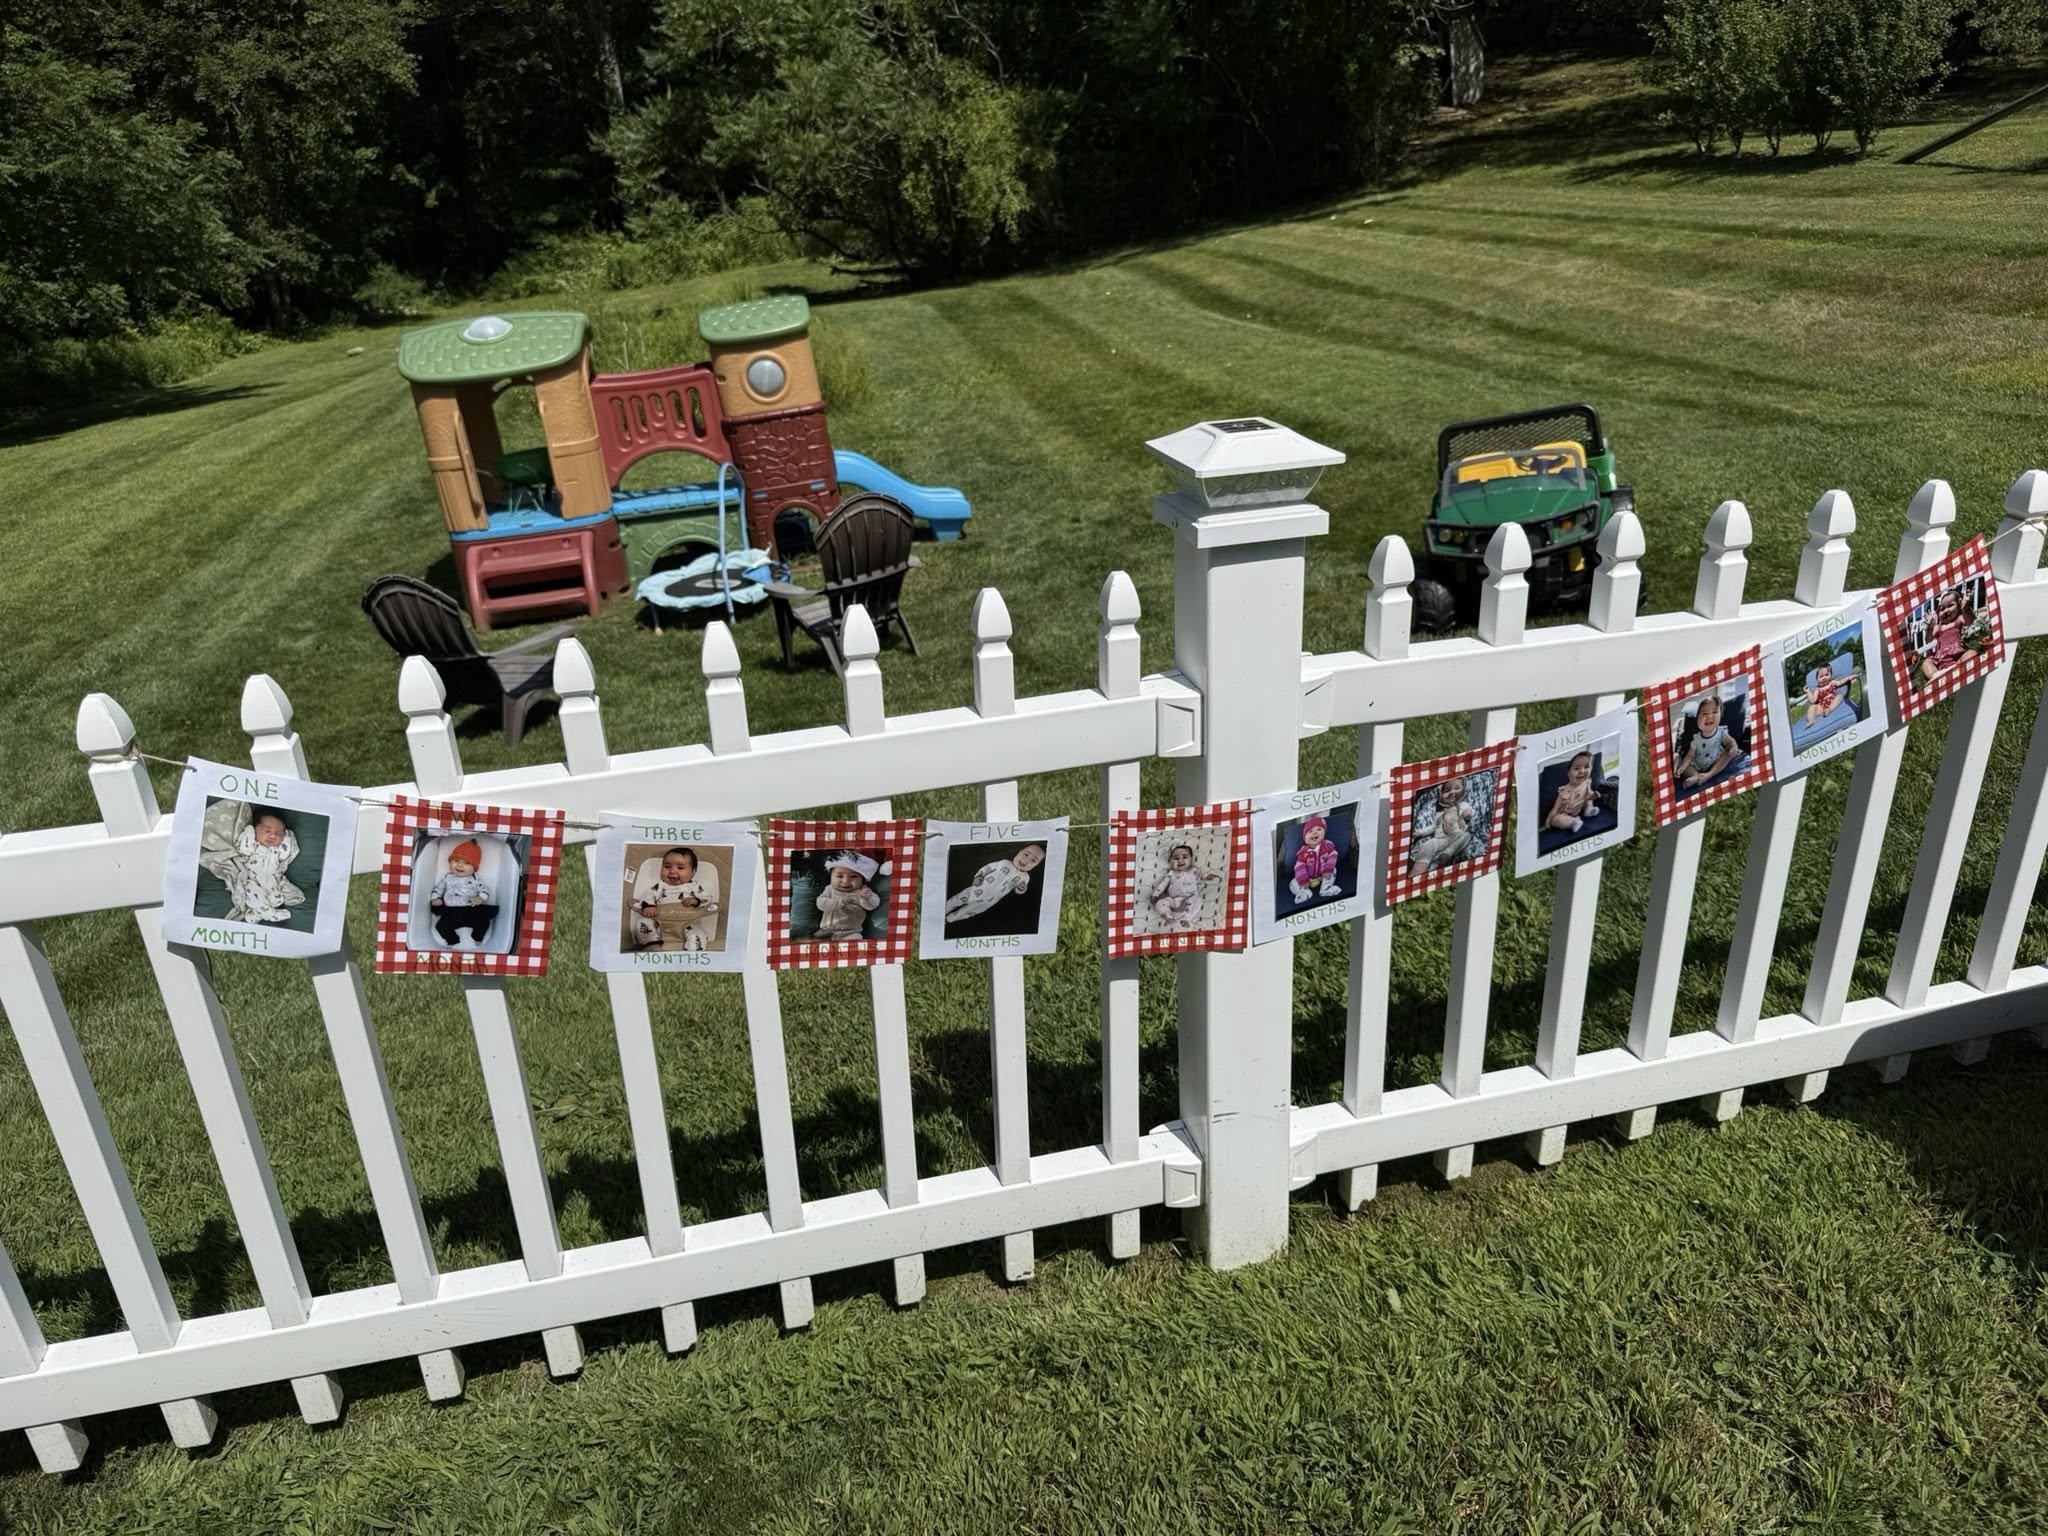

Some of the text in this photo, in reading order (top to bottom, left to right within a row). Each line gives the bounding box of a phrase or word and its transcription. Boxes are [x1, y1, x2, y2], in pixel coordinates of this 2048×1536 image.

[1783, 614, 1845, 654] ELEVEN
[1545, 728, 1589, 753] NINE
[1800, 728, 1858, 763] MONTHS
[220, 774, 278, 800] ONE
[1290, 788, 1342, 811] SEVEN
[632, 825, 704, 841] THREE
[970, 824, 1024, 841] FIVE
[1550, 835, 1604, 861] MONTHS
[1284, 901, 1346, 928] MONTHS
[191, 927, 268, 950] MONTH
[955, 936, 1021, 949] MONTHS
[633, 952, 711, 966] MONTHS
